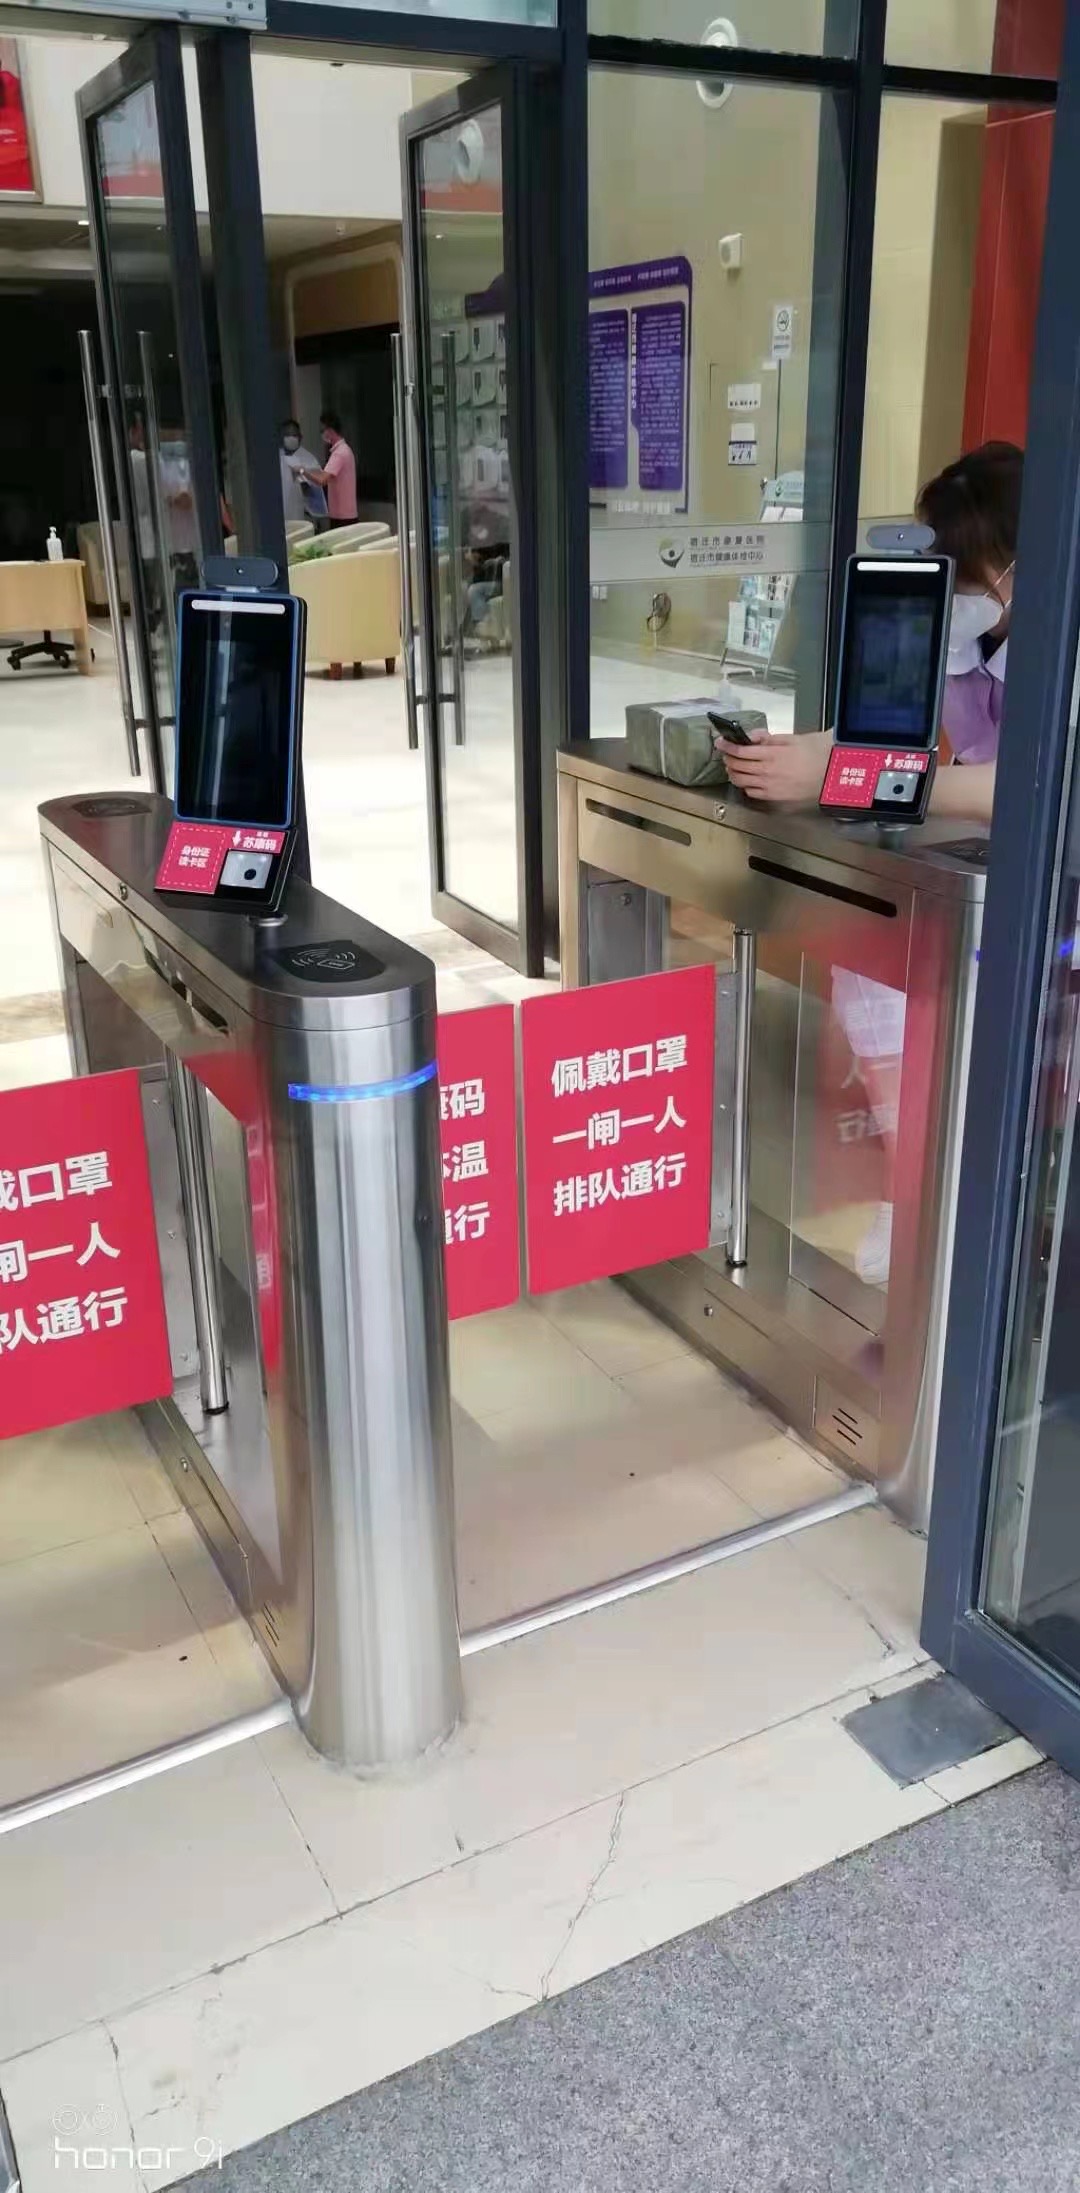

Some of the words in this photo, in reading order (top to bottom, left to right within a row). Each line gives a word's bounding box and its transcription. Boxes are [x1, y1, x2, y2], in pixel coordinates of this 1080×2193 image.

[842, 768, 866, 777] 身份证
[179, 857, 207, 868] 读卡区
[182, 846, 210, 857] 身份证
[243, 837, 276, 850] 苏康码
[551, 1034, 688, 1097] 佩戴口罩
[552, 1095, 687, 1150] 一闸一人
[442, 1140, 489, 1182] 温
[553, 1152, 687, 1217] 排队通行
[444, 1201, 490, 1245] 行
